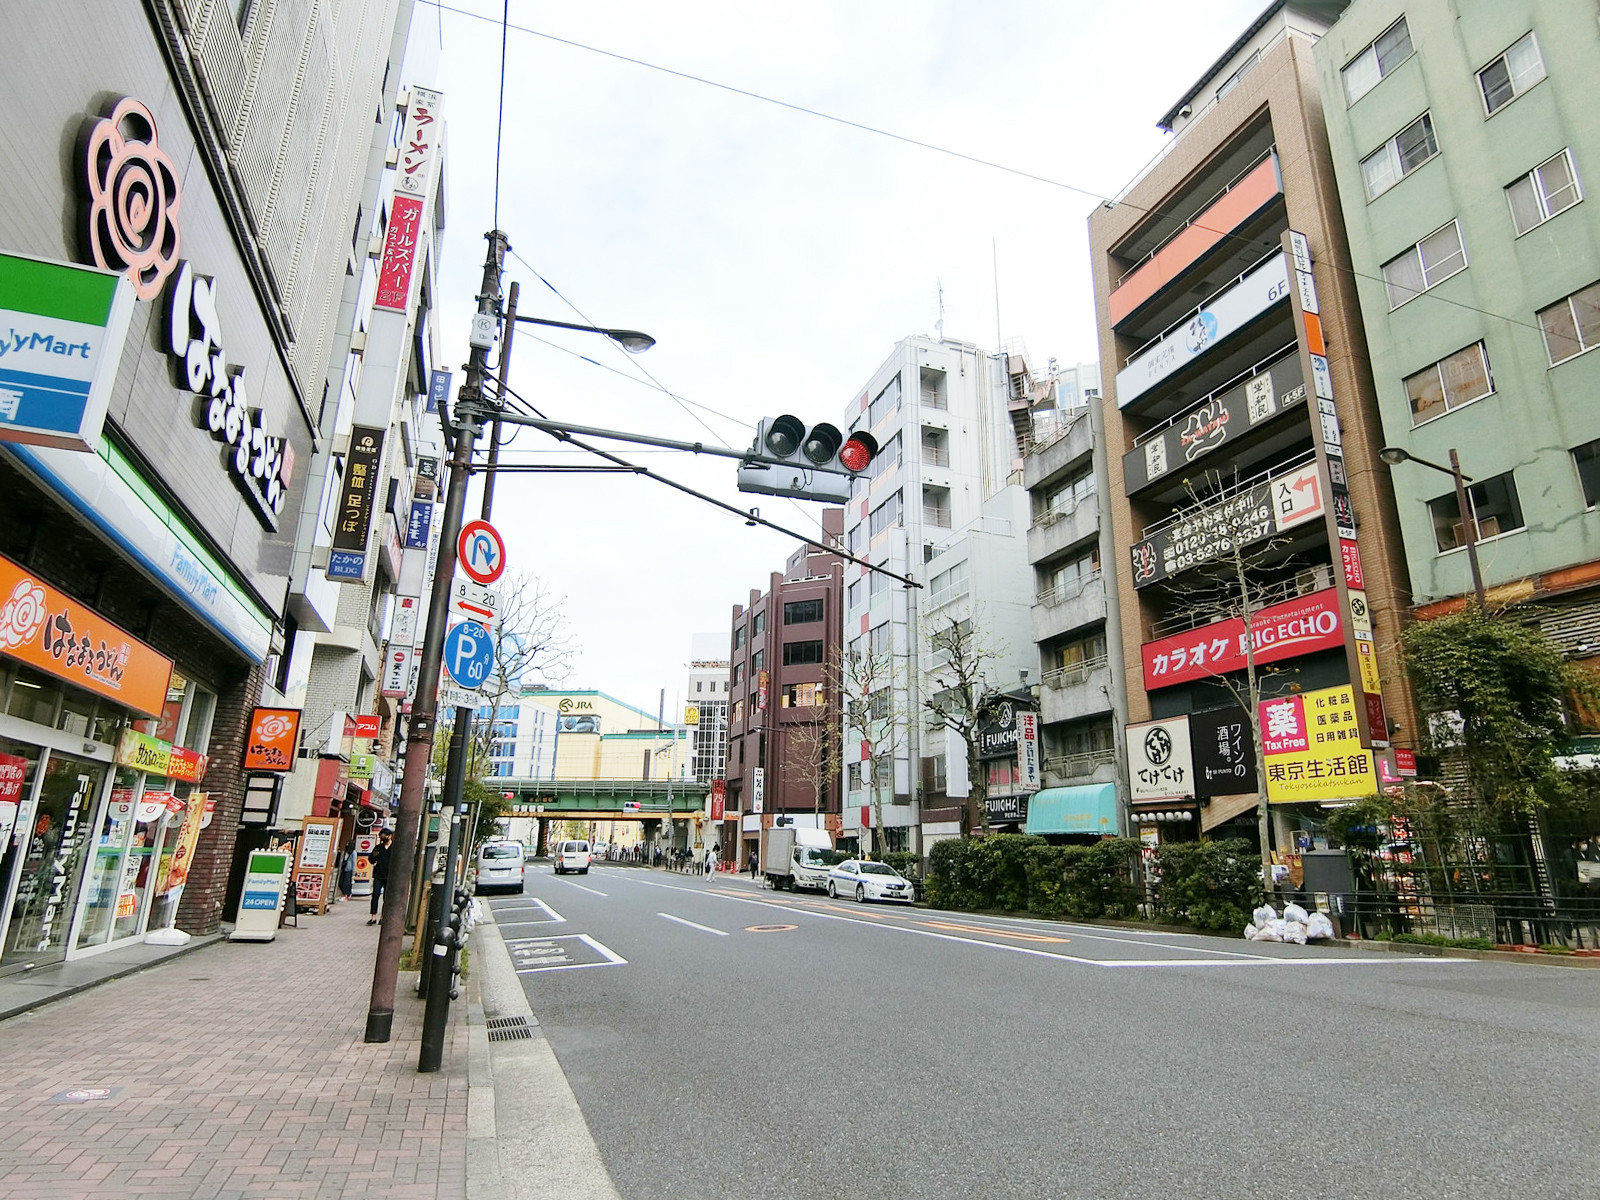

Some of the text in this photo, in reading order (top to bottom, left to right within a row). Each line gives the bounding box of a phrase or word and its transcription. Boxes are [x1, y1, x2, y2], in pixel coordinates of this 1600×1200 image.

[405, 108, 434, 174] ラーメン
[392, 208, 419, 288] ガールズバー
[1268, 280, 1287, 302] 6F
[171, 260, 287, 516] はなまるうどん
[351, 463, 368, 489] 整体
[1279, 483, 1294, 514] 入口
[342, 494, 363, 533] 足つぼ
[415, 540, 426, 548] 4F
[331, 552, 364, 566] たかの
[333, 565, 358, 575] BLDG
[460, 585, 466, 596] 8
[482, 593, 495, 607] 20
[462, 624, 485, 639] 8-20
[1277, 610, 1338, 640] ECHO
[44, 608, 124, 682] はなまるうどん
[454, 634, 477, 675] P
[1152, 638, 1229, 676] カラオケ
[467, 662, 483, 680] 60
[575, 701, 593, 709] JRA
[1316, 693, 1350, 708] 化粧品
[357, 723, 377, 731] アコム
[1266, 702, 1298, 738] 薬
[1317, 710, 1353, 726] 医薬品
[1264, 738, 1306, 751] Tax Free
[1316, 727, 1358, 743] 日用雑貨
[1231, 724, 1246, 777] ワインの
[1138, 764, 1185, 786] てけてけ
[1268, 754, 1369, 782] 東京生活館
[1280, 778, 1364, 792] Tokyoseikatsukan
[37, 774, 90, 953] FamilyMart
[254, 898, 275, 906] OPEN
